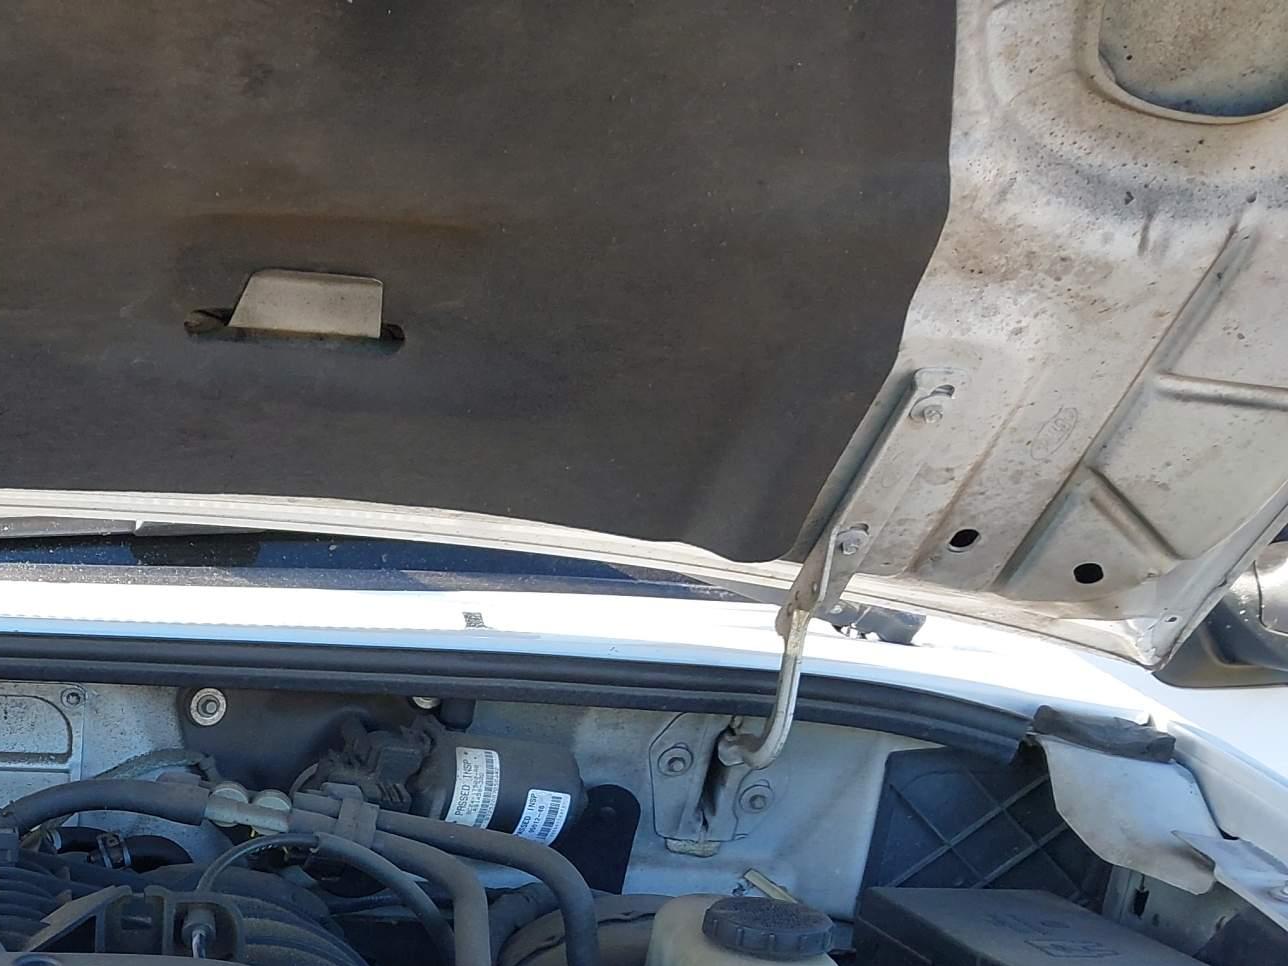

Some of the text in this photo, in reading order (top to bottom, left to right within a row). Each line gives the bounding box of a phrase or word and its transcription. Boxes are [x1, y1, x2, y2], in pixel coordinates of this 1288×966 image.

[455, 759, 472, 816] PASSED INSP
[527, 793, 537, 811] INSP
